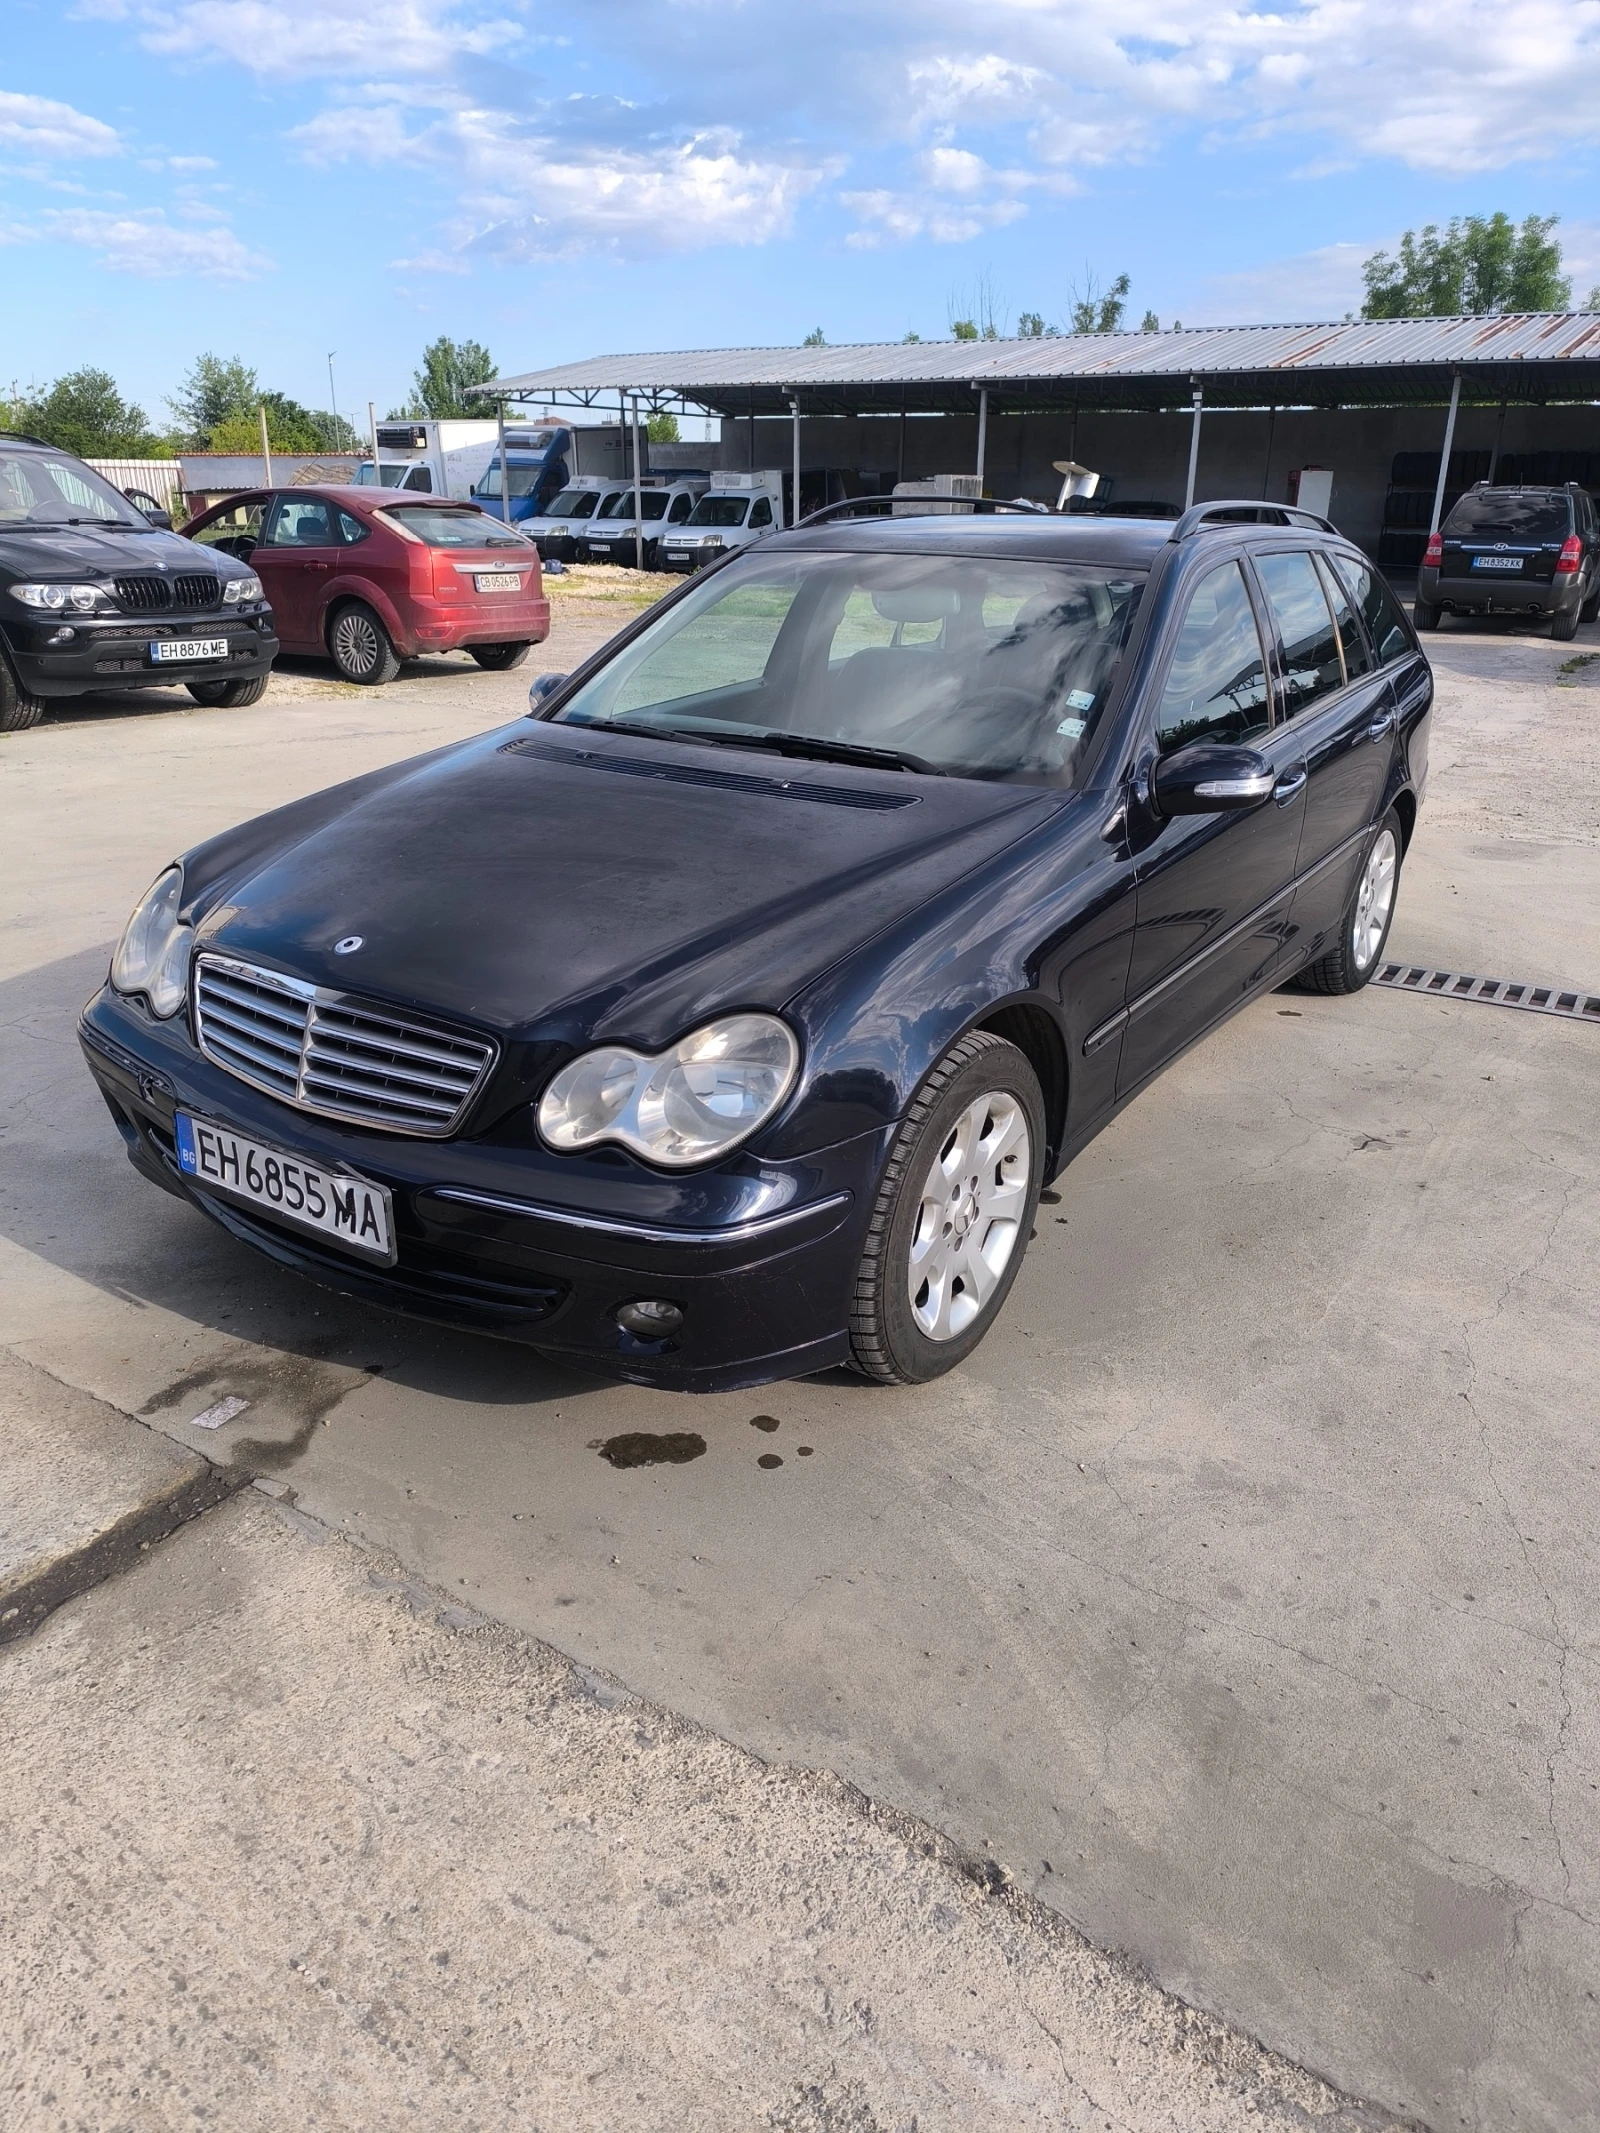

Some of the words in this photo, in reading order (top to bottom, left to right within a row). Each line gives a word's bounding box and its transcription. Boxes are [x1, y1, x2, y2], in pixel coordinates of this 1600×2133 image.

[1479, 558, 1490, 566] EH
[1510, 559, 1521, 567] KK
[480, 576, 490, 587] CB
[160, 644, 177, 657] EH
[180, 642, 208, 656] 8876
[210, 641, 225, 654] ME
[182, 1148, 195, 1164] BG
[197, 1127, 240, 1185] EH
[246, 1150, 326, 1219] 6855
[330, 1183, 380, 1242] MA
